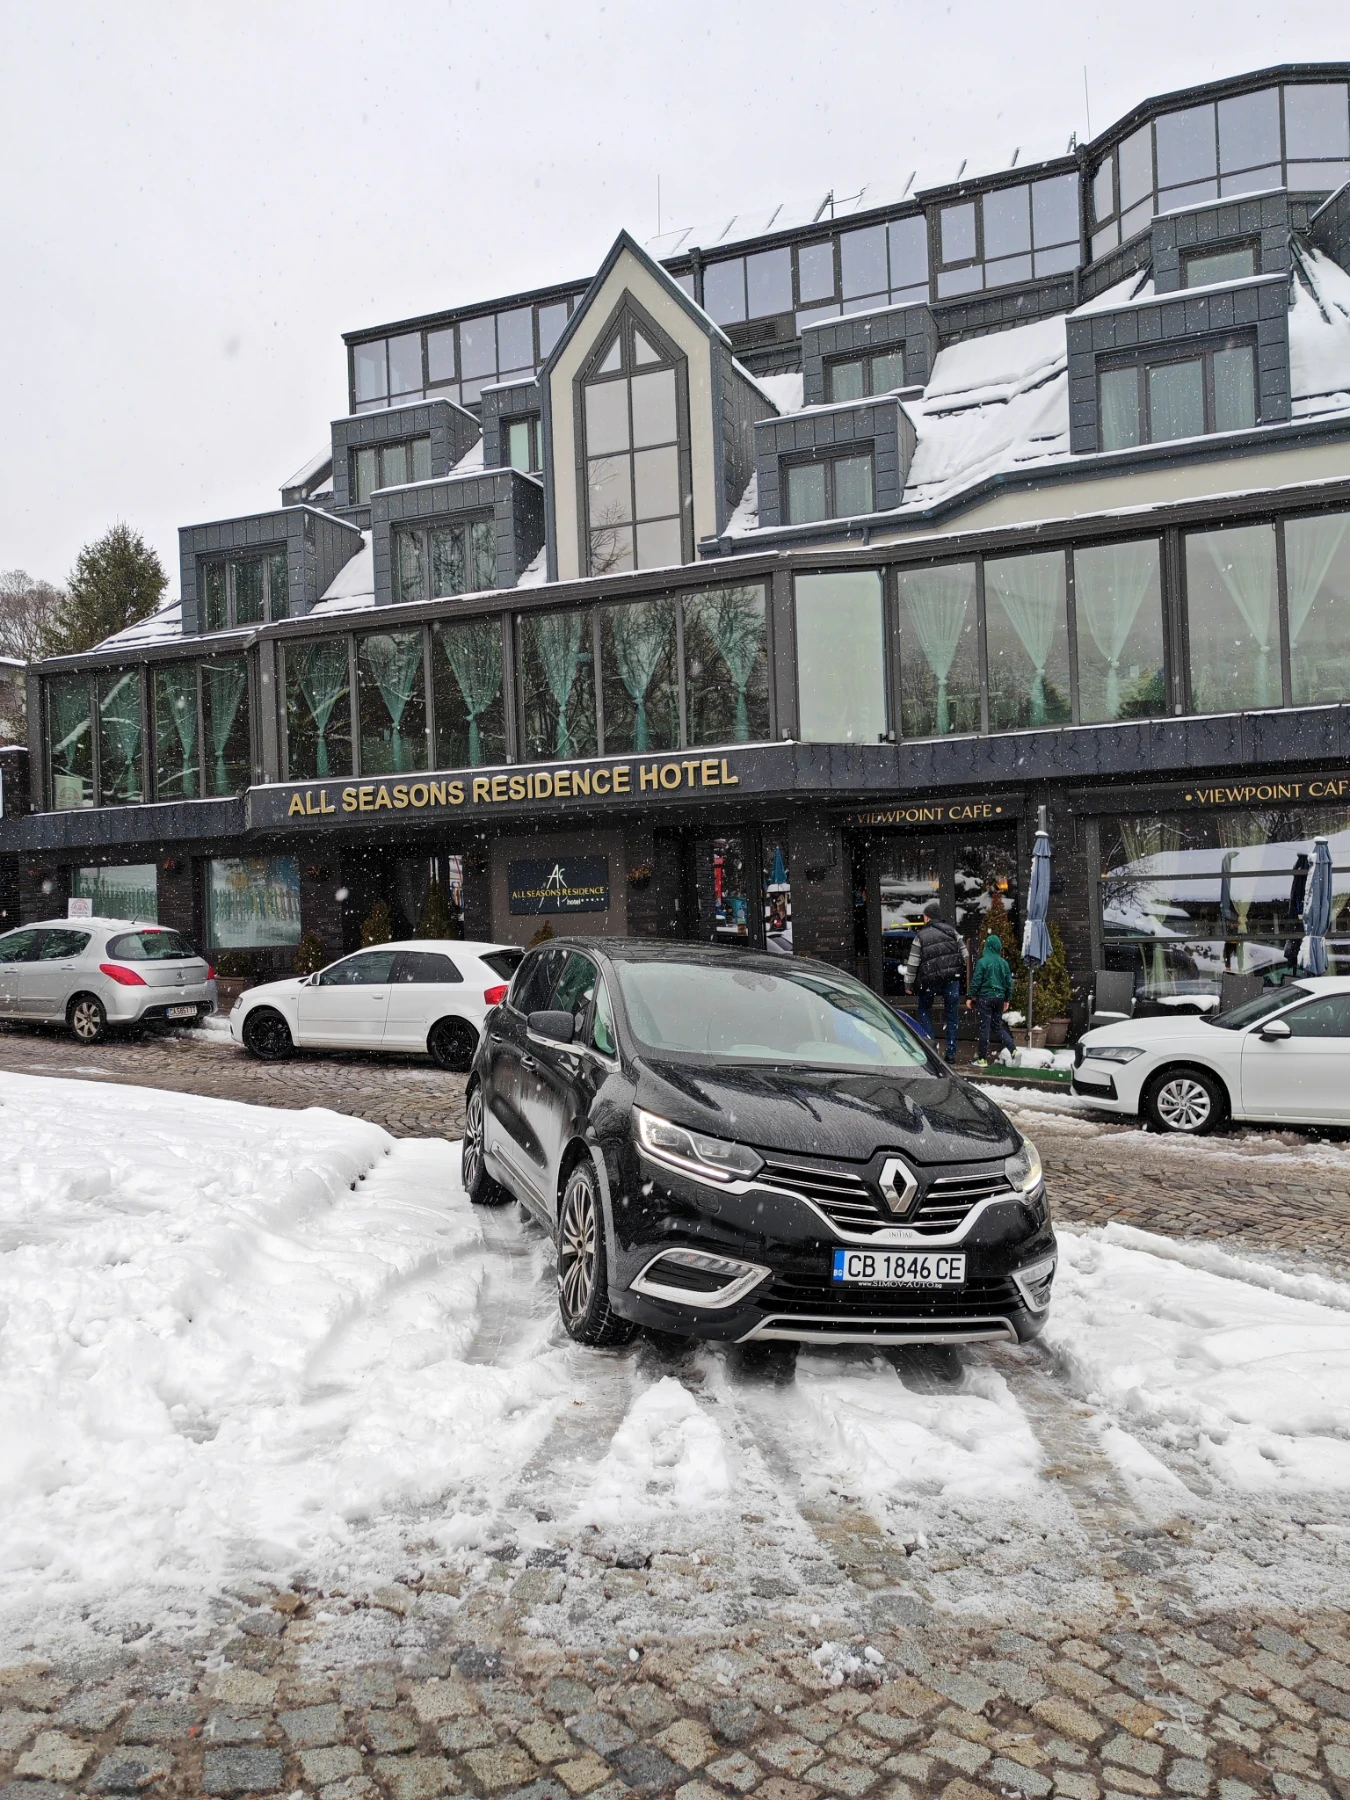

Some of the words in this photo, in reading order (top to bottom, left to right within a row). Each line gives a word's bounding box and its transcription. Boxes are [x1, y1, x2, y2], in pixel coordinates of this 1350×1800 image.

[287, 789, 335, 816] ALL
[341, 781, 465, 812] SEASONS
[472, 766, 631, 803] RESIDENCE
[639, 758, 739, 791] HOTEL
[1196, 783, 1303, 804] VIEWPOINT
[1308, 780, 1349, 796] CAF
[857, 807, 944, 824] VIEWPOINT
[948, 804, 992, 820] CAFE
[512, 890, 526, 899] ALL
[526, 888, 561, 899] SEASONS
[562, 886, 605, 896] RESIDENCE
[833, 1269, 843, 1277] BG
[847, 1254, 876, 1278] CB
[883, 1256, 931, 1280] 1846
[936, 1257, 962, 1280] CE
